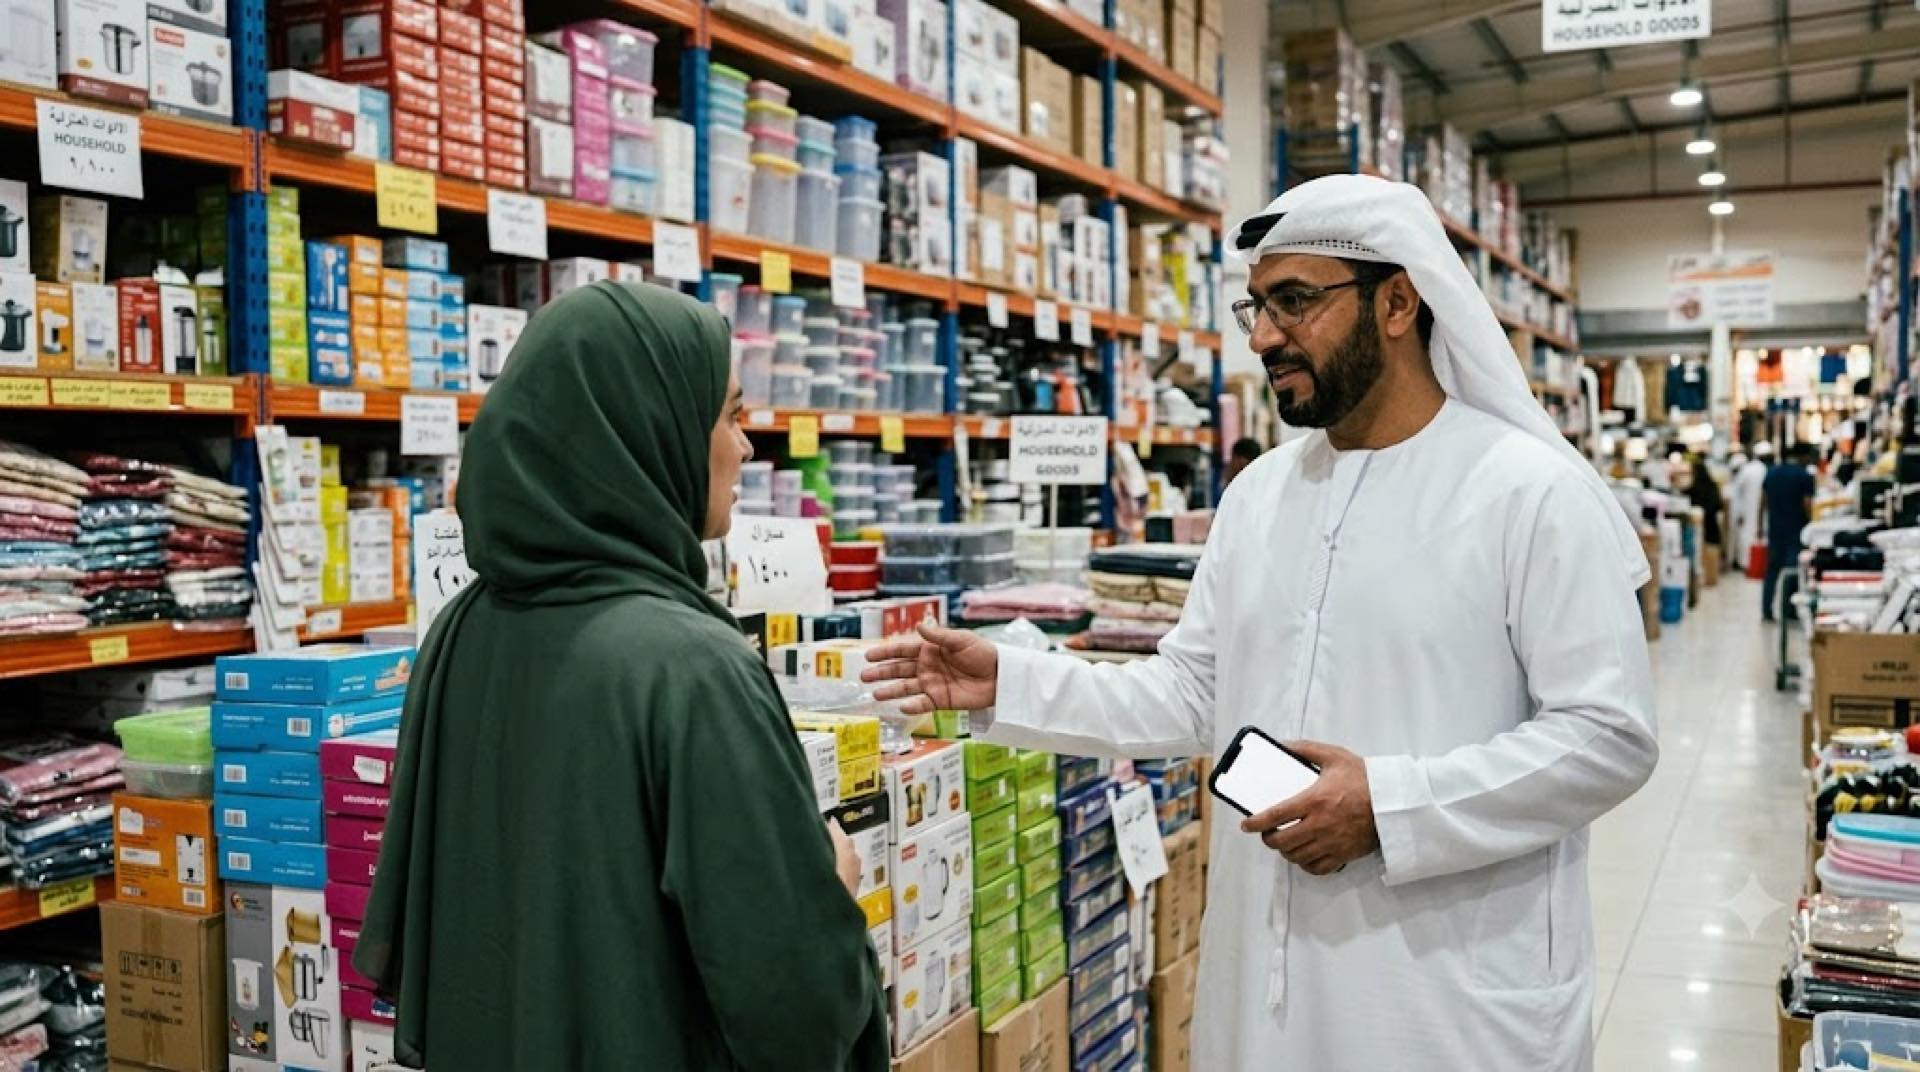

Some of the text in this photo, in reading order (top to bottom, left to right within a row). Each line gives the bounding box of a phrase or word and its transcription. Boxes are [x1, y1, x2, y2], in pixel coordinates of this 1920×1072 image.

[1553, 15, 1700, 42] HOUSEHOLD GOODS
[54, 131, 127, 154] HOUSEHOLD
